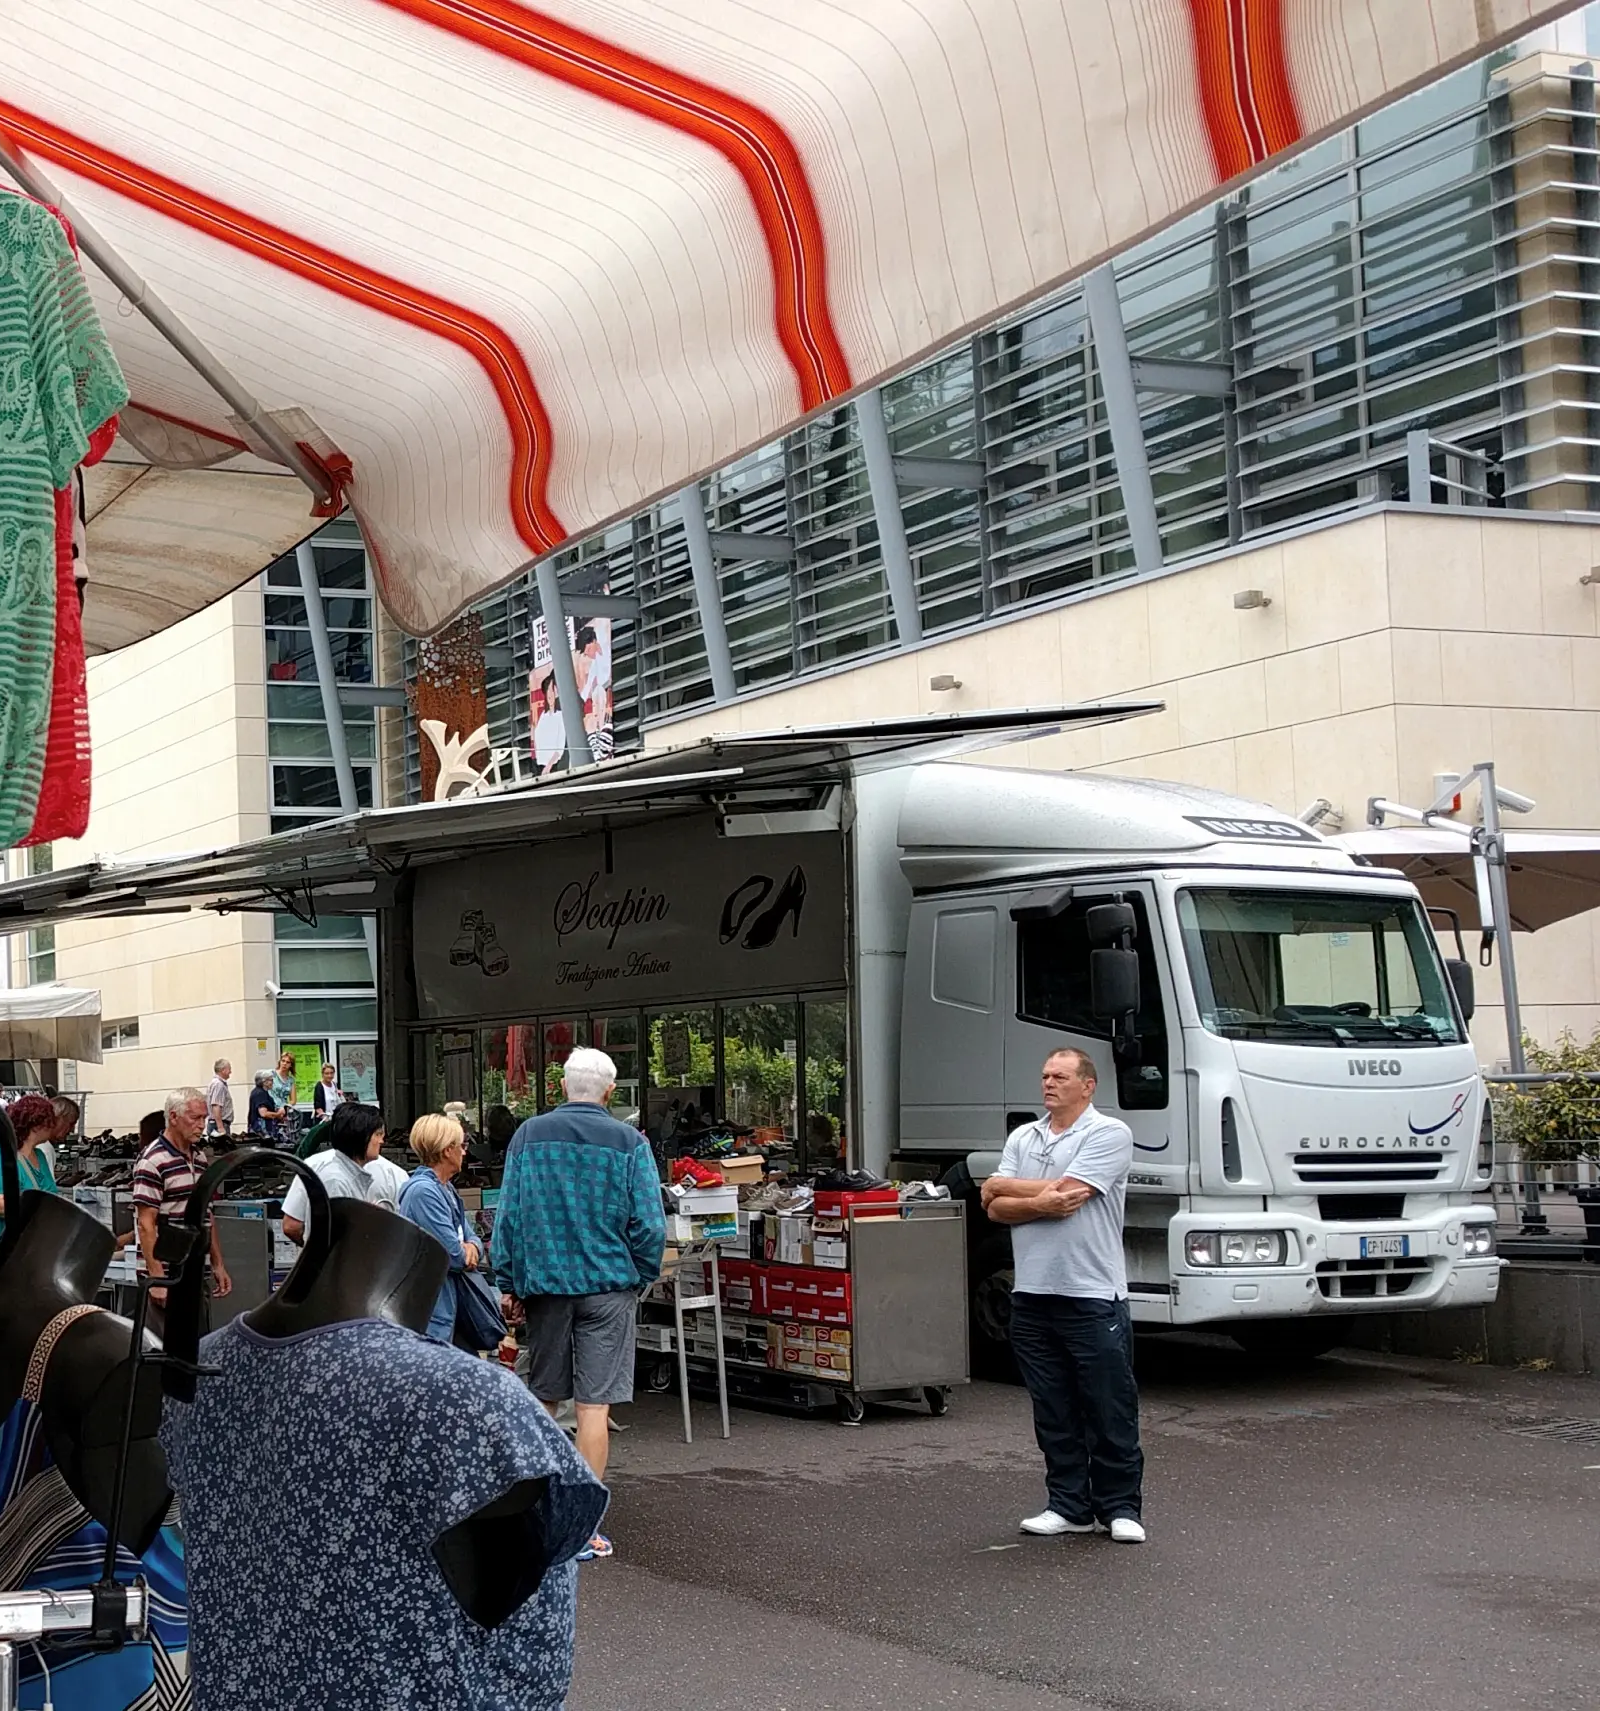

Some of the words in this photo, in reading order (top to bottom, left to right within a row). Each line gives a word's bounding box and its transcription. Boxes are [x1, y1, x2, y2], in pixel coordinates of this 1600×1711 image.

[1200, 819, 1302, 837] IVECO
[554, 871, 670, 950] Scapin
[555, 960, 620, 992] Tradizione
[622, 951, 671, 977] Antica
[1348, 1059, 1402, 1076] IVECO
[1299, 1135, 1451, 1149] EUROCARGO
